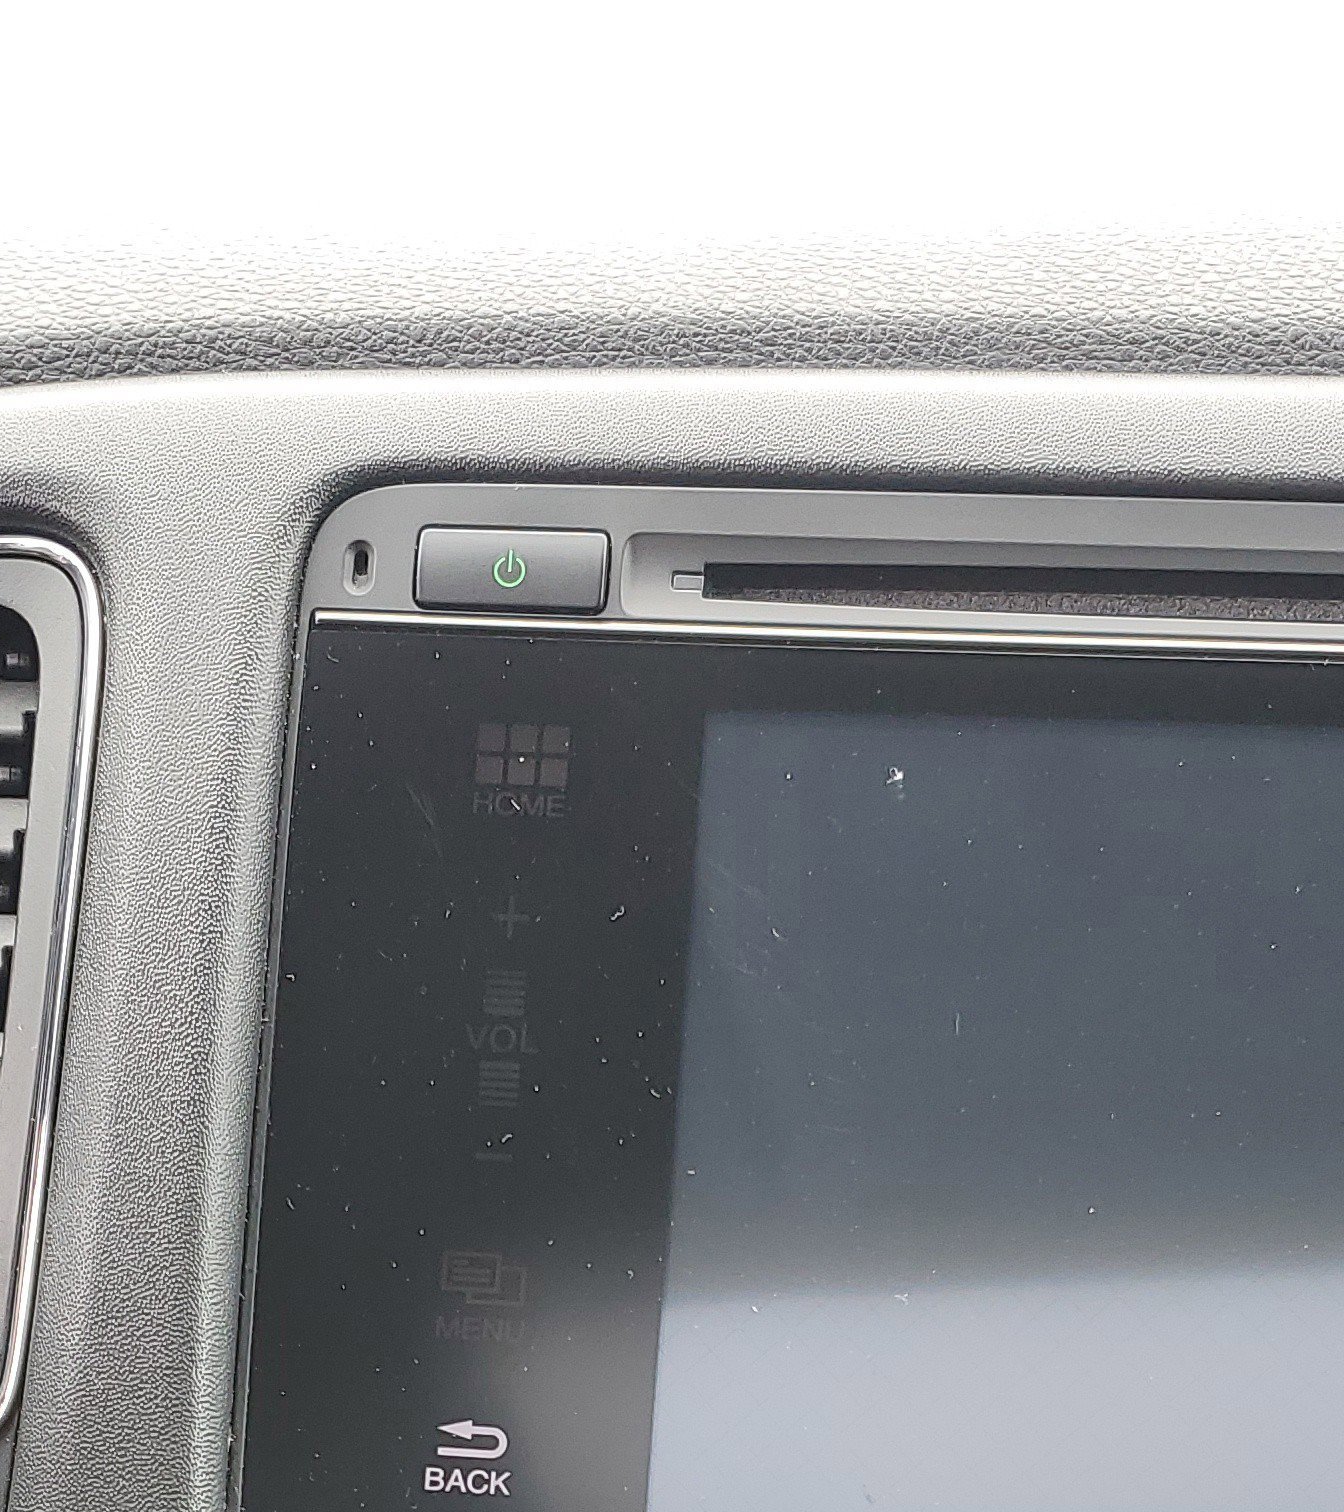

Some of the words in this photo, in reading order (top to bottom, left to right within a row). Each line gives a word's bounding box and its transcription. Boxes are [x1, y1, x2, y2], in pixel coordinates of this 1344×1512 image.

[472, 791, 567, 818] HOME
[465, 1022, 539, 1055] VOL
[434, 1315, 525, 1343] MENU
[423, 1466, 512, 1496] BACK
